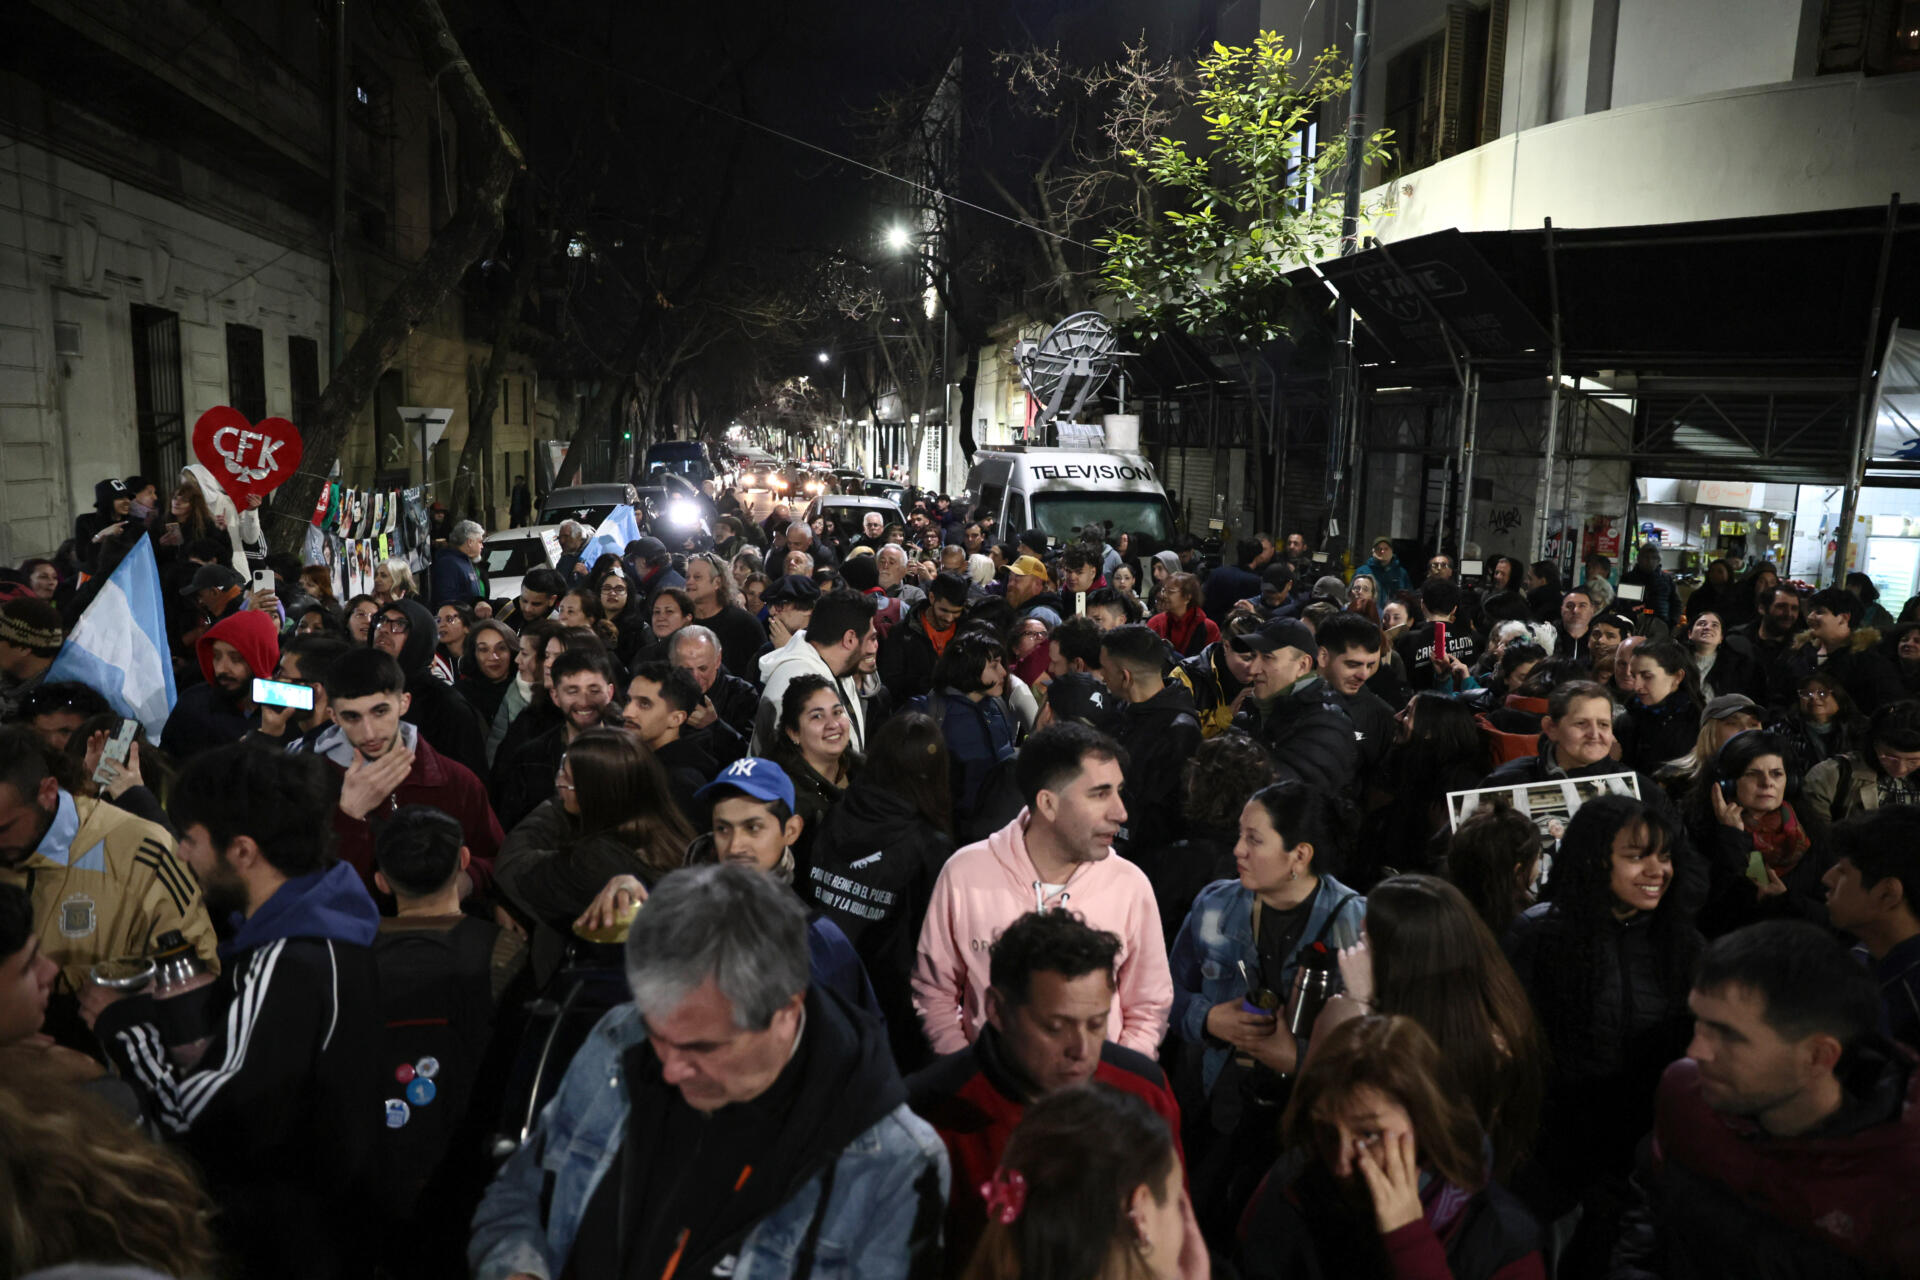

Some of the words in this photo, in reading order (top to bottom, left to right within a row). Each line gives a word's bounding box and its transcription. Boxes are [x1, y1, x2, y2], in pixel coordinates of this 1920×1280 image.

[213, 426, 285, 471] CFK
[1030, 465, 1152, 480] TELEVISION
[1449, 637, 1473, 651] CLOTH
[833, 895, 842, 908] Y
[840, 896, 851, 911] LA
[869, 888, 898, 906] PUEBL
